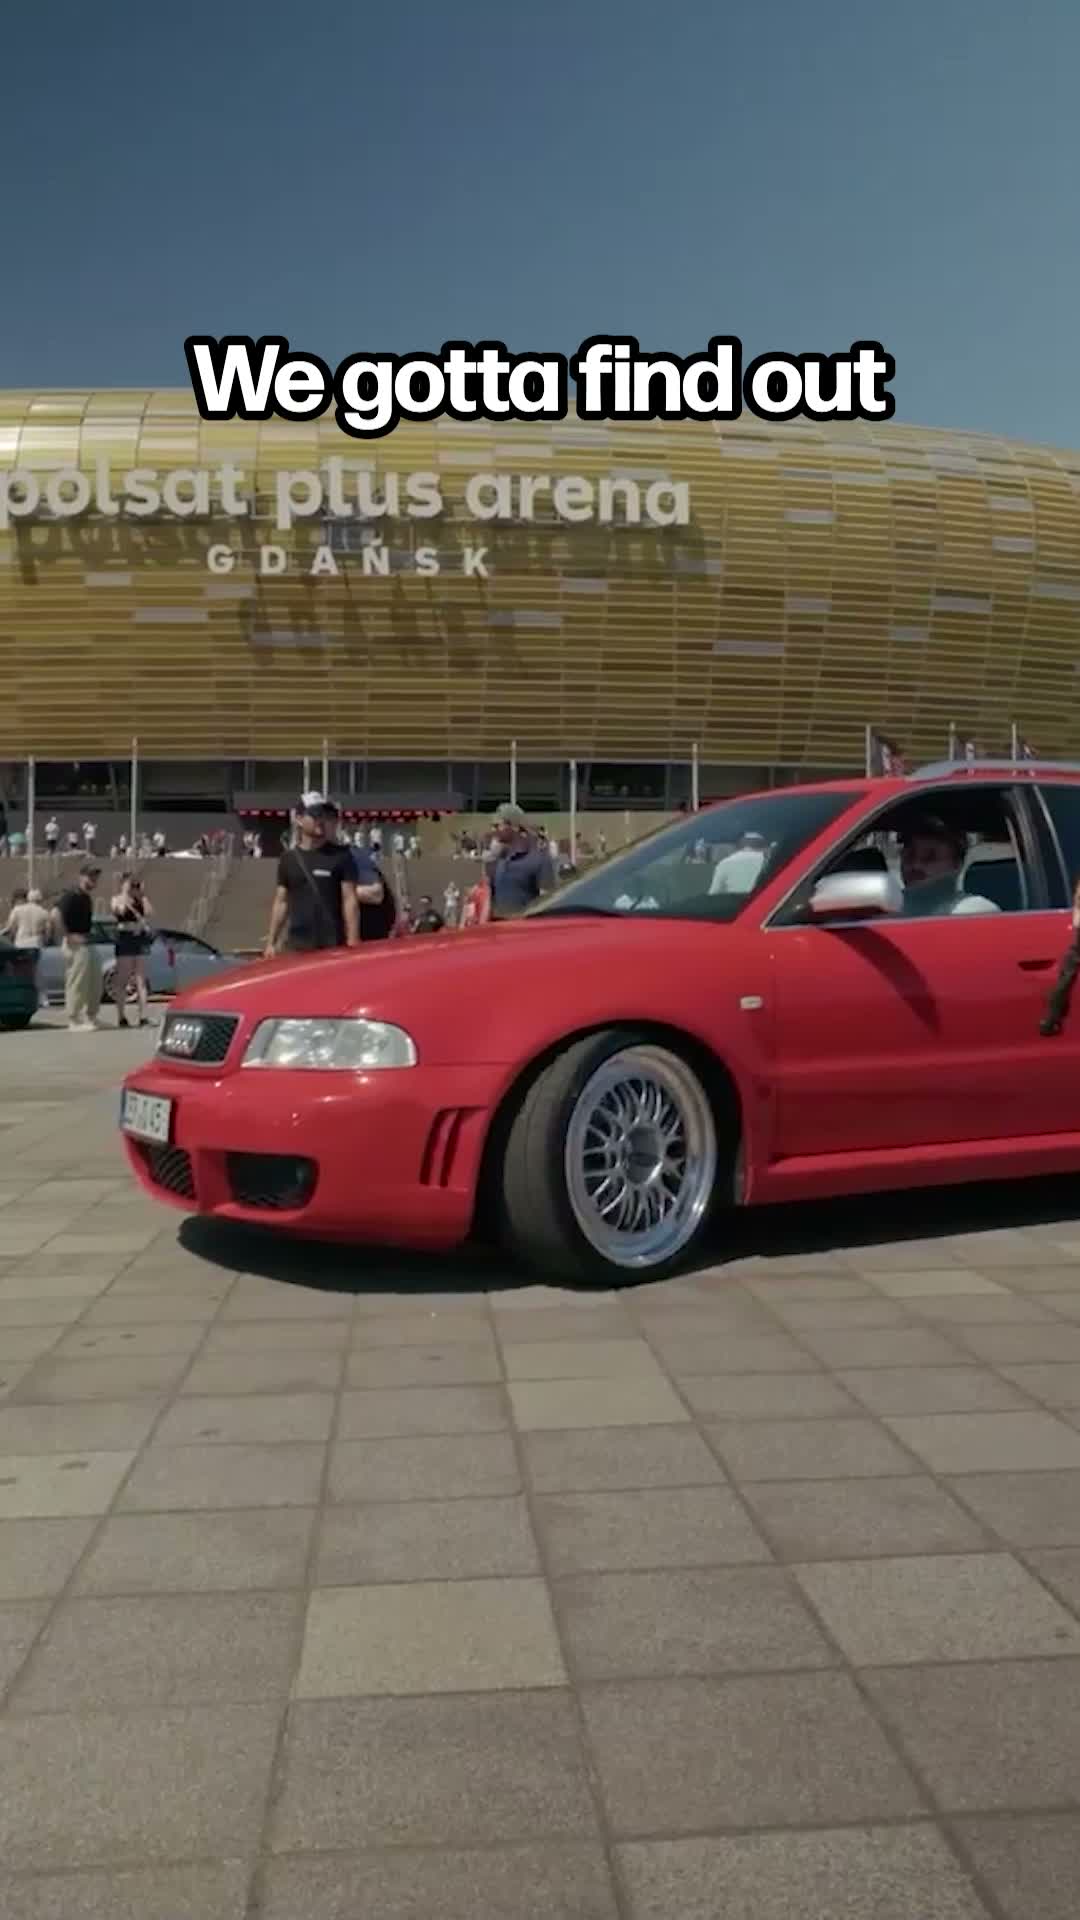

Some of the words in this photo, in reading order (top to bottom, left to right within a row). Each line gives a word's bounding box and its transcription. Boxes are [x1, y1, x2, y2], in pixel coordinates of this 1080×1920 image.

[0, 455, 248, 530] polsat
[275, 455, 444, 530] plus
[464, 472, 691, 527] arena
[206, 536, 490, 577] GDAŃSK
